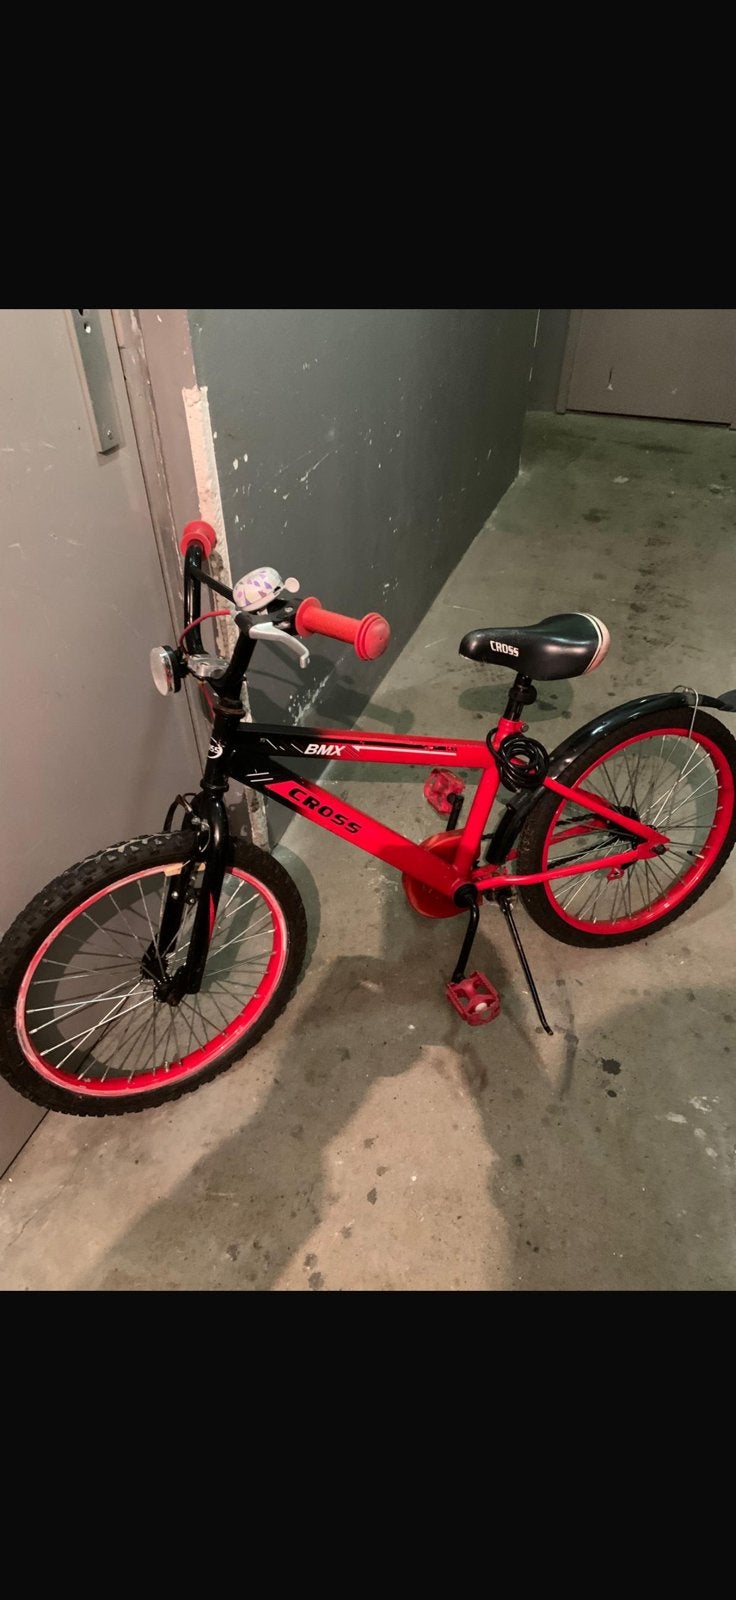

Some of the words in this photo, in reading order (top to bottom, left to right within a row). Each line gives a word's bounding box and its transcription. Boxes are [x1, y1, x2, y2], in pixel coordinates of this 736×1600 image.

[489, 640, 519, 658] CROSS
[303, 743, 346, 757] BMX
[288, 788, 363, 834] CROSS
